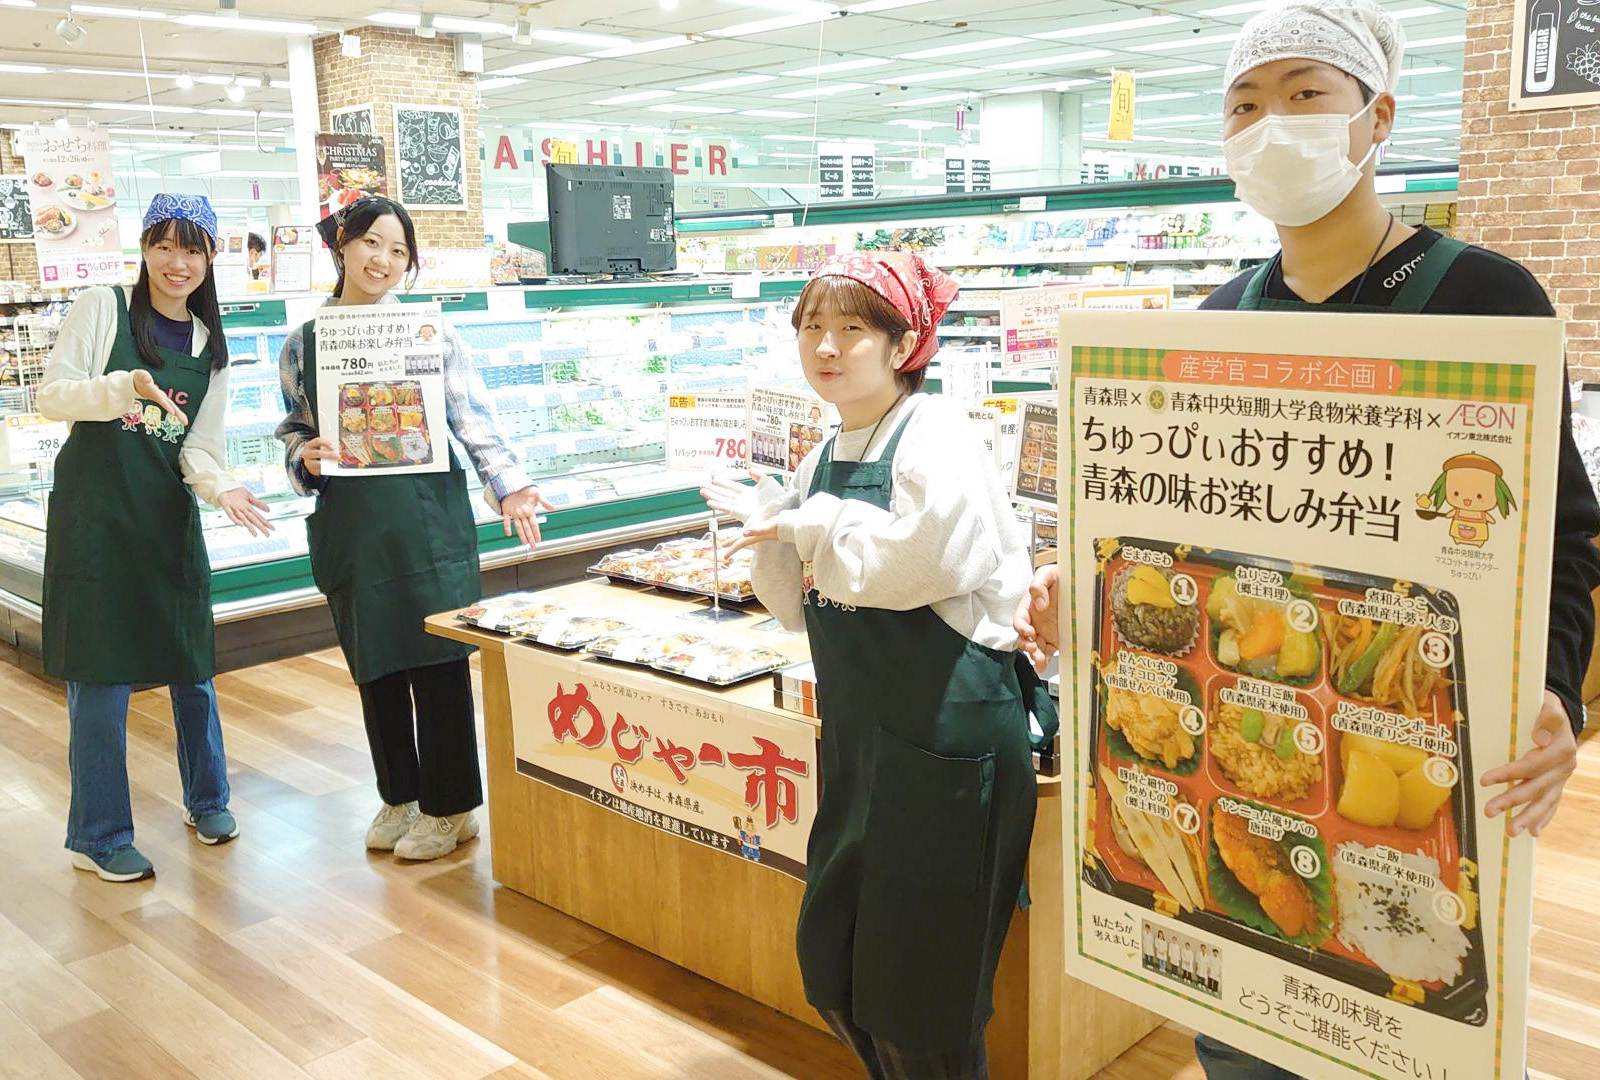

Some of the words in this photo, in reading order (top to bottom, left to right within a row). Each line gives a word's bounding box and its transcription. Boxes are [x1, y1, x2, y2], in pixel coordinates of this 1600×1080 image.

[1535, 28, 1550, 74] VINEGAR
[322, 145, 377, 157] CHRISTMAS
[319, 336, 413, 352] 青森の味お楽しみ弁当
[1178, 355, 1396, 392] 産学官コラボ企画！
[38, 438, 60, 450] 298
[1446, 431, 1513, 445] イオン東北株式会社
[1081, 462, 1401, 542] 青森の味お楽しみ弁当
[1122, 547, 1172, 567] ごまおこわ
[1434, 555, 1499, 571] マスコットキャラクター
[1441, 546, 1494, 561] 青森中央短期大学
[1236, 566, 1284, 586] ねりこみ
[1366, 588, 1428, 612] 煮和えっこ
[1118, 651, 1177, 674] せんべい衣の
[1119, 663, 1177, 688] 長芋コロッケ
[1238, 677, 1295, 702] 鶏五目ご飯
[1338, 701, 1452, 739] リンゴのコンポート
[629, 779, 705, 815] 決め手は、青森県産。
[589, 787, 730, 850] イオンは地産地消を推進しています
[1218, 797, 1318, 838] ヤンニョム風サバの
[1248, 820, 1284, 842] 唐揚げ
[1375, 846, 1401, 864] ご飯
[1092, 914, 1133, 935] 私たちが
[1094, 929, 1140, 950] 考えました
[1282, 973, 1403, 1041] 青森の味覚を
